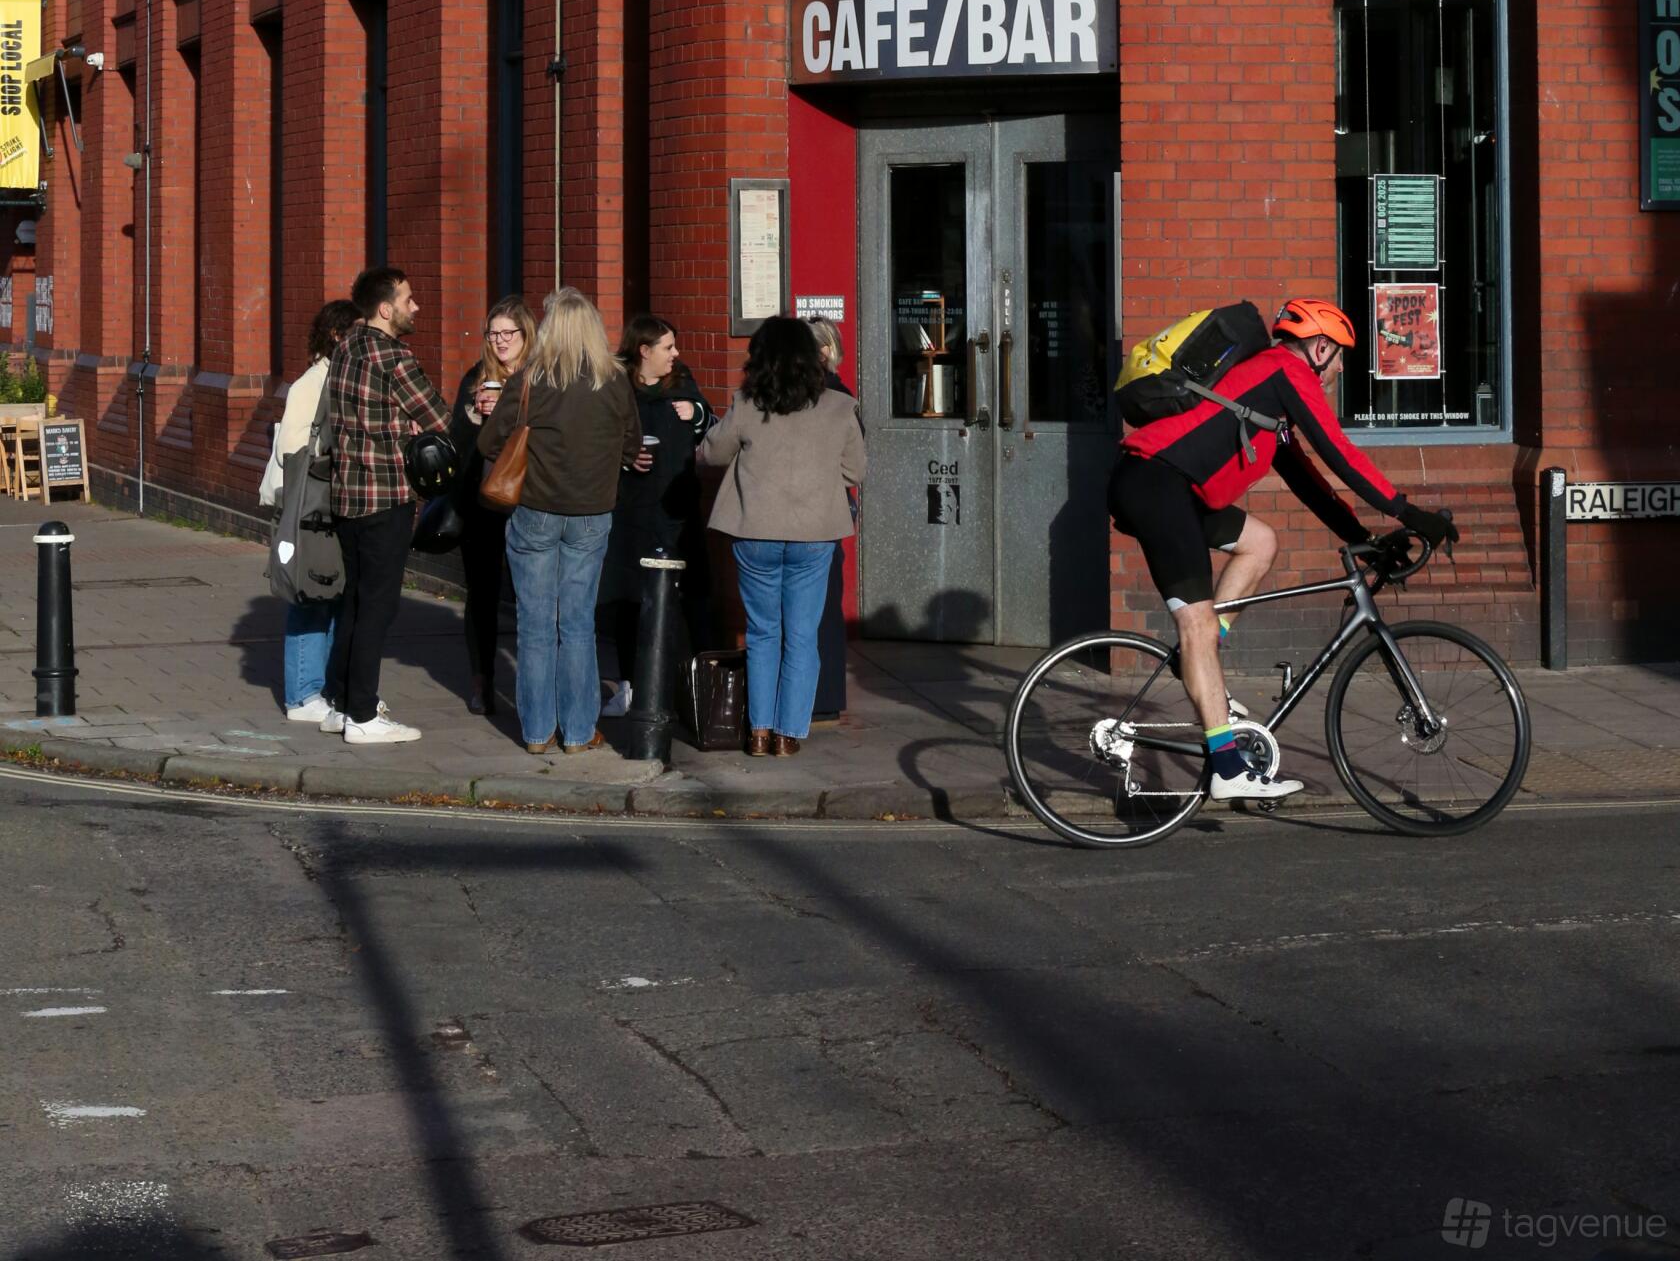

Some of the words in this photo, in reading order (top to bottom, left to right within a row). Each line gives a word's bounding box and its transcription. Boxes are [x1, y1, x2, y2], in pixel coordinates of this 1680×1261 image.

[1, 19, 23, 71] LOCAL
[1, 73, 22, 116] SHOP
[1377, 180, 1386, 200] 2025
[796, 298, 808, 309] NO
[809, 298, 844, 309] SMOKING
[1386, 295, 1427, 312] SPOOK
[1392, 309, 1421, 325] FEST
[1421, 412, 1428, 420] BY
[1430, 412, 1443, 420] THIS
[1444, 412, 1470, 420] WINDOW
[928, 460, 959, 475] Ced
